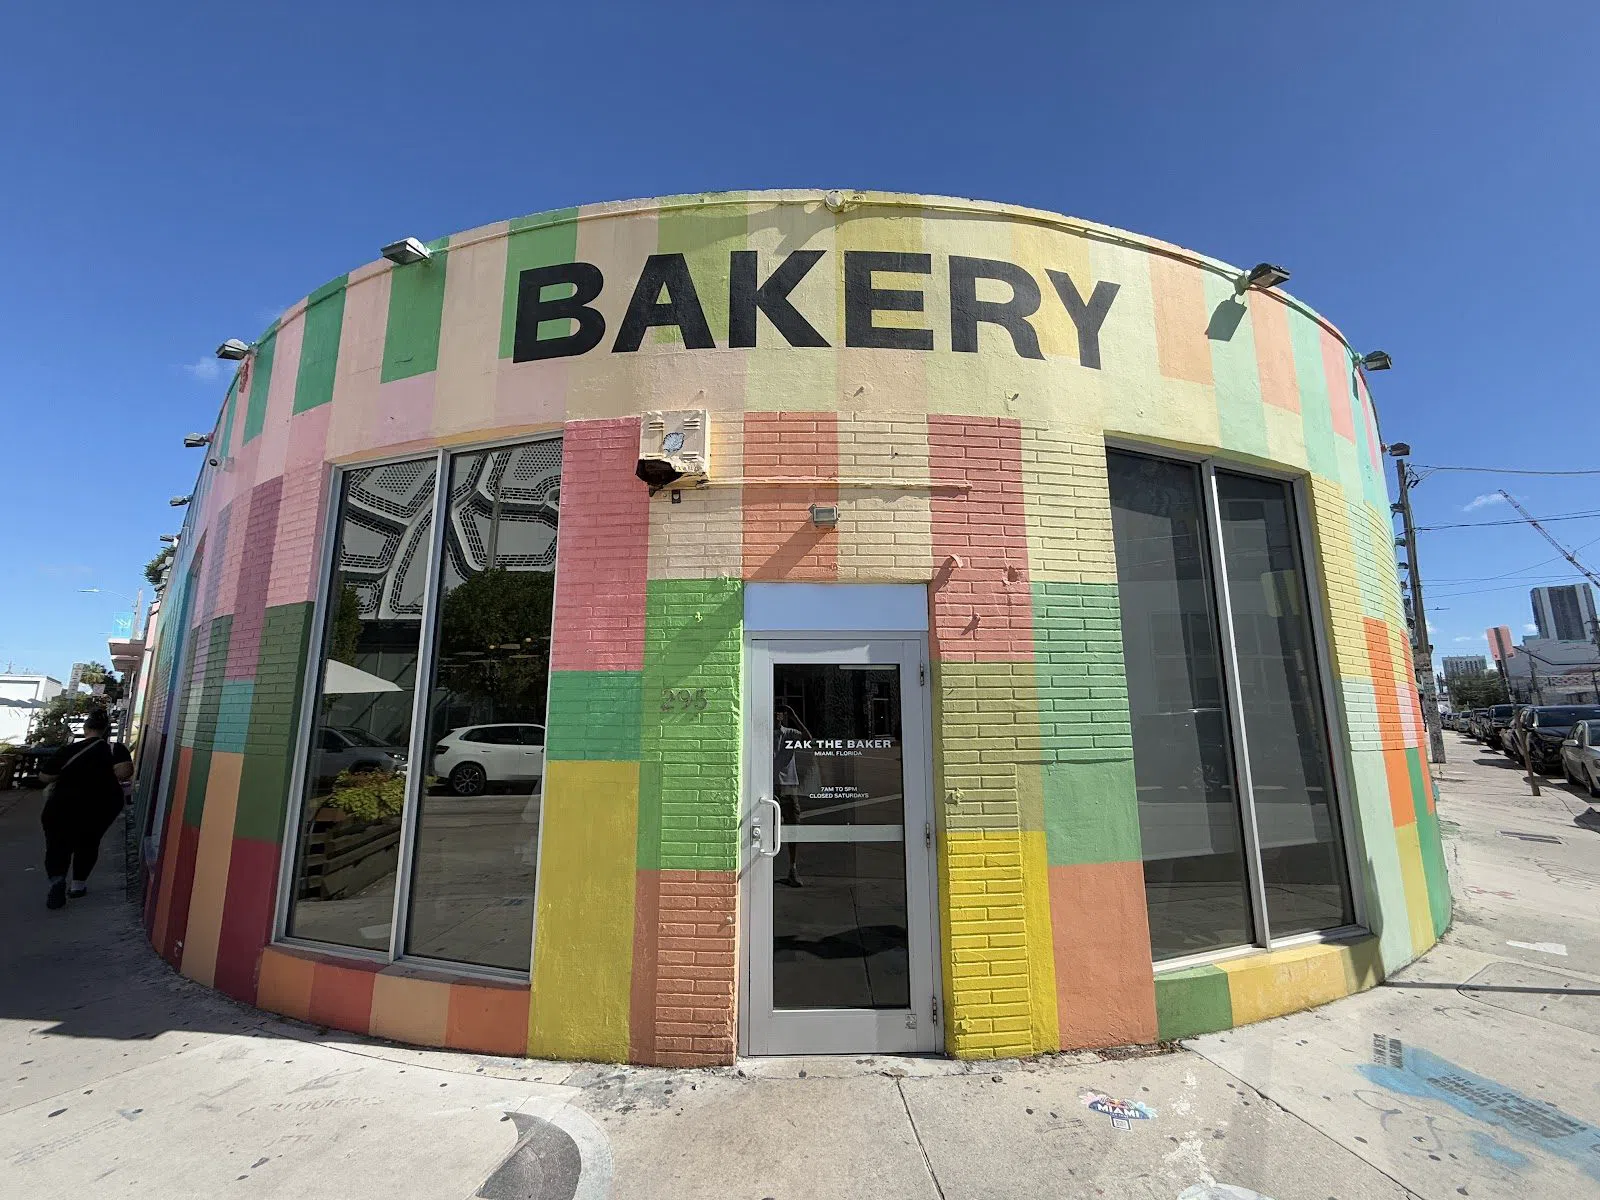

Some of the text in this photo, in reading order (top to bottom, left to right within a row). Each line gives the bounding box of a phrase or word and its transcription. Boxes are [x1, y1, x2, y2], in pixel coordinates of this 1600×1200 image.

[513, 250, 1121, 370] BAKERY
[661, 688, 708, 711] 295
[785, 740, 891, 749] ZAK THE BAKER
[1097, 1103, 1140, 1118] MIAMI
